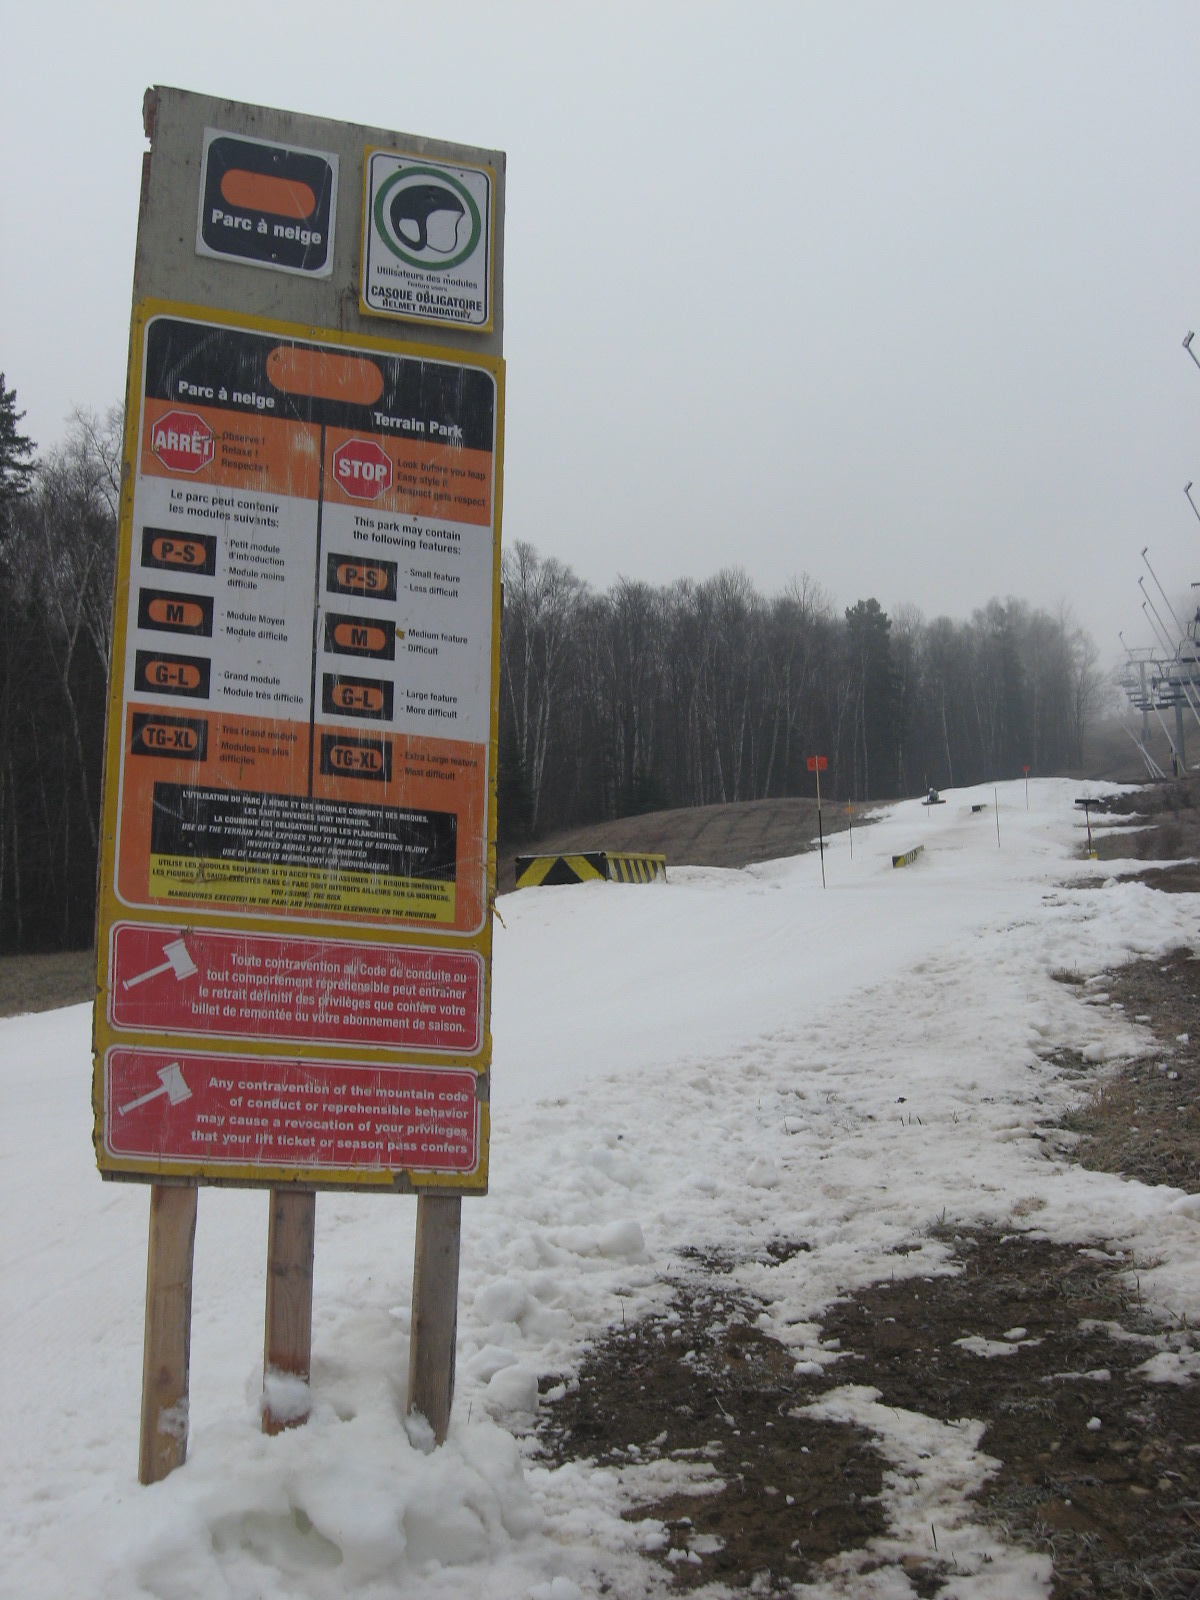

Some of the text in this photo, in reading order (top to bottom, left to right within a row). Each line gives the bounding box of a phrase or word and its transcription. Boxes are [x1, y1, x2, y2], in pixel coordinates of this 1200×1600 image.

[212, 209, 321, 245] Parc à neige
[377, 266, 478, 289] Utilisateurs des modules
[371, 286, 482, 311] CASQUE OBLIGATOIRE
[382, 299, 471, 319] HELMET MANDATORY
[178, 380, 275, 409] Parc à neige
[374, 412, 463, 438] Terrain Park
[156, 430, 212, 455] ARRÊT
[339, 458, 387, 481] STOP
[398, 459, 418, 469] Look
[451, 467, 465, 479] you
[468, 470, 485, 480] leap
[398, 474, 417, 483] Easy
[419, 477, 439, 487] style
[171, 489, 279, 513] Le parc peut contenir
[397, 485, 431, 497] Respect
[455, 495, 485, 508] respect
[169, 503, 279, 528] les modules suivants:
[355, 516, 461, 541] This park may contain
[162, 541, 195, 563] P-S
[230, 539, 280, 554] Petit module
[353, 530, 461, 554] the following features:
[229, 551, 285, 566] d'introduction
[227, 579, 257, 590] difficile
[229, 567, 285, 582] Module moins
[346, 568, 377, 588] P-S
[410, 569, 460, 583] Small feature
[409, 584, 458, 598] Less difficult
[166, 604, 183, 622] M
[227, 611, 285, 626] Module Moyen
[226, 627, 288, 642] Module difficile
[351, 628, 367, 647] M
[408, 629, 468, 644] Medium feature
[408, 644, 438, 655] Difficult
[156, 662, 188, 686] G-L
[224, 671, 280, 685] Grand module
[224, 687, 303, 704] Module très difficile
[342, 688, 373, 708] G-L
[406, 690, 457, 703] Large feature
[406, 705, 457, 719] More difficult
[147, 728, 192, 748] TG-XL
[221, 741, 255, 754] Modules
[272, 747, 289, 757] plus
[334, 748, 378, 769] TG-XL
[219, 754, 255, 765] difficiles
[405, 751, 477, 768] Extra Large feature
[405, 768, 455, 780] Most difficult
[317, 815, 334, 823] SONT
[231, 953, 261, 967] Toute
[265, 958, 340, 973] contravention
[361, 964, 386, 976] Code
[390, 966, 402, 977] de
[406, 969, 450, 982] conduite
[454, 973, 466, 983] ou
[207, 968, 466, 999] tout comportement répréhensible peut entraîner
[199, 985, 466, 1016] le retrait définitif des privilèges que confère votre
[192, 1002, 464, 1032] billet de remontée ou votre abonnement de saison.
[209, 1077, 468, 1102] Any contravention of the mountain code
[230, 1096, 468, 1118] of conduct or reprehensible behavior
[197, 1114, 467, 1138] may cause a revocation of your privileges
[191, 1130, 467, 1154] that your lift ticket or season pass confers
